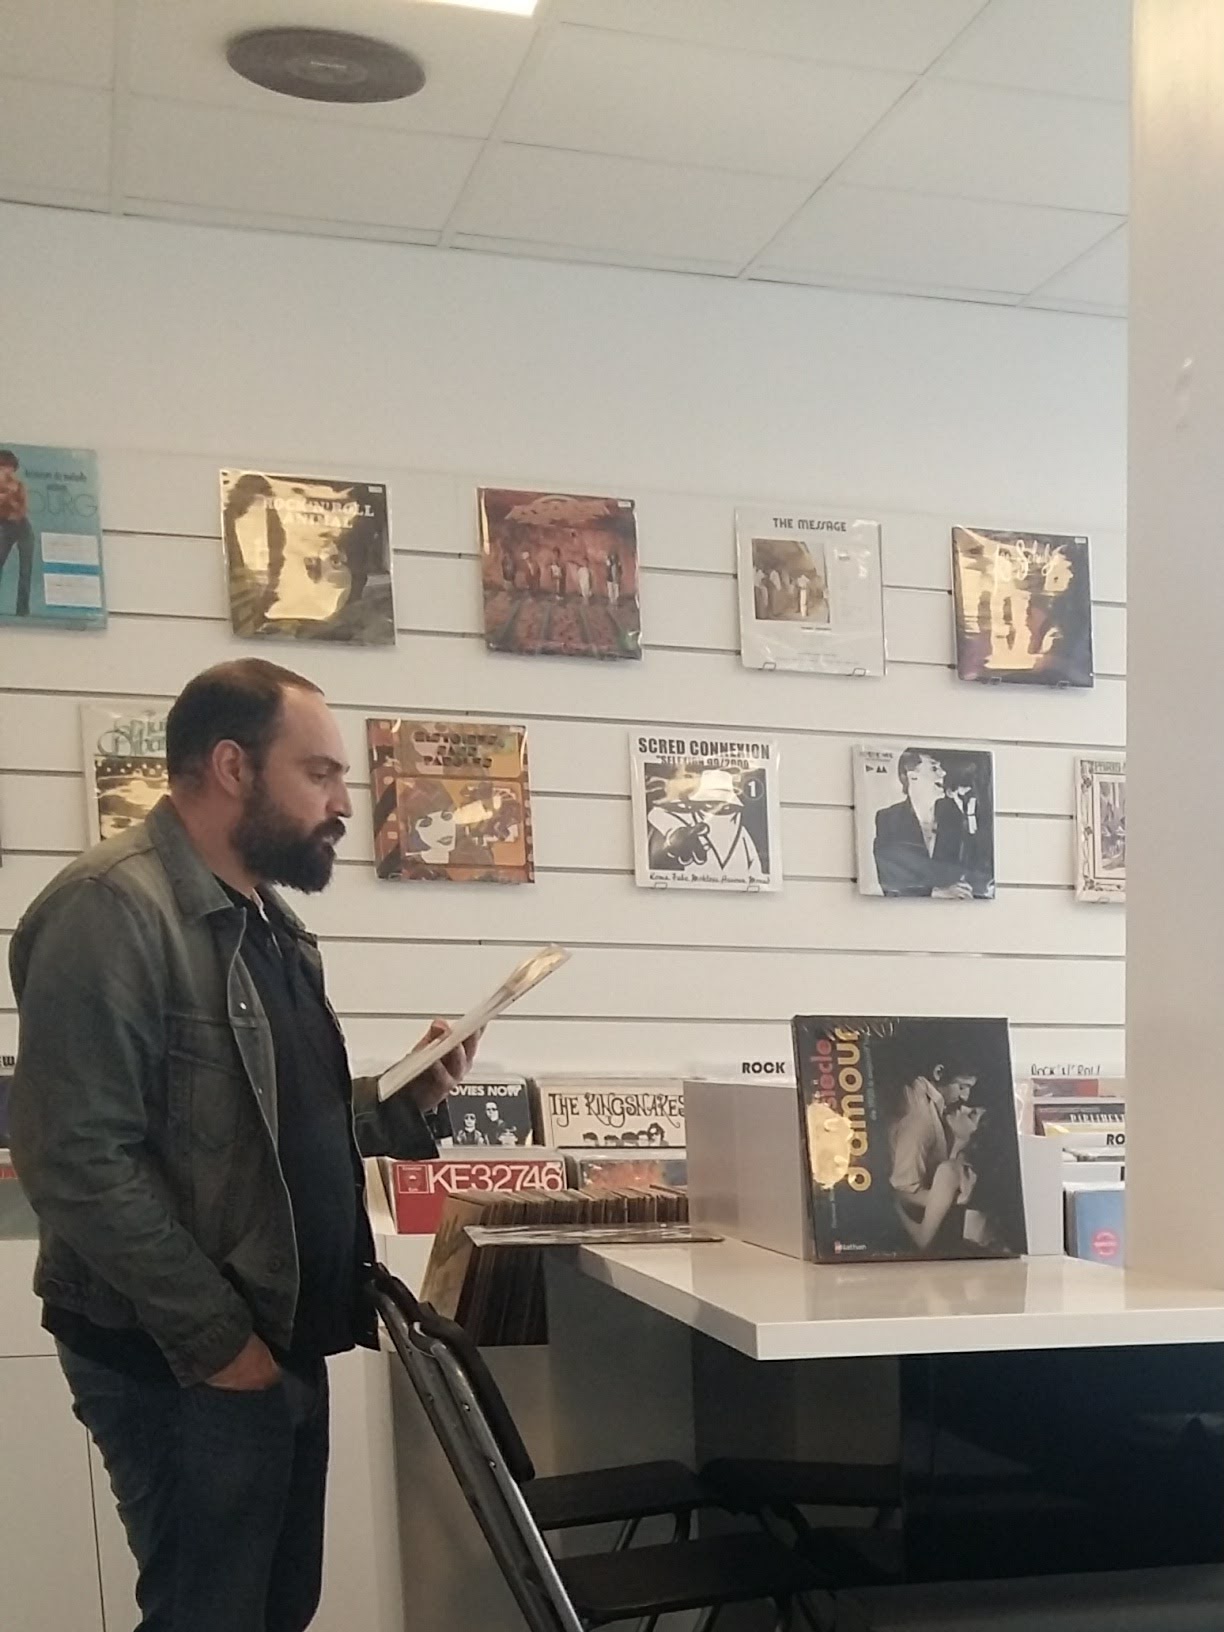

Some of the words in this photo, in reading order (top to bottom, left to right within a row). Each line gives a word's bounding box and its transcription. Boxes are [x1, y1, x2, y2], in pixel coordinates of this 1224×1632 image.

[773, 518, 793, 529] THE
[798, 519, 847, 531] MESSAGE
[638, 738, 685, 755] SCRED
[690, 740, 770, 759] CONNEXION
[749, 781, 756, 797] 1
[741, 1062, 786, 1074] ROCK
[450, 1084, 484, 1097] OVIES
[488, 1084, 521, 1097] NOW
[548, 1093, 580, 1127] THE
[430, 1163, 563, 1194] KE32746
